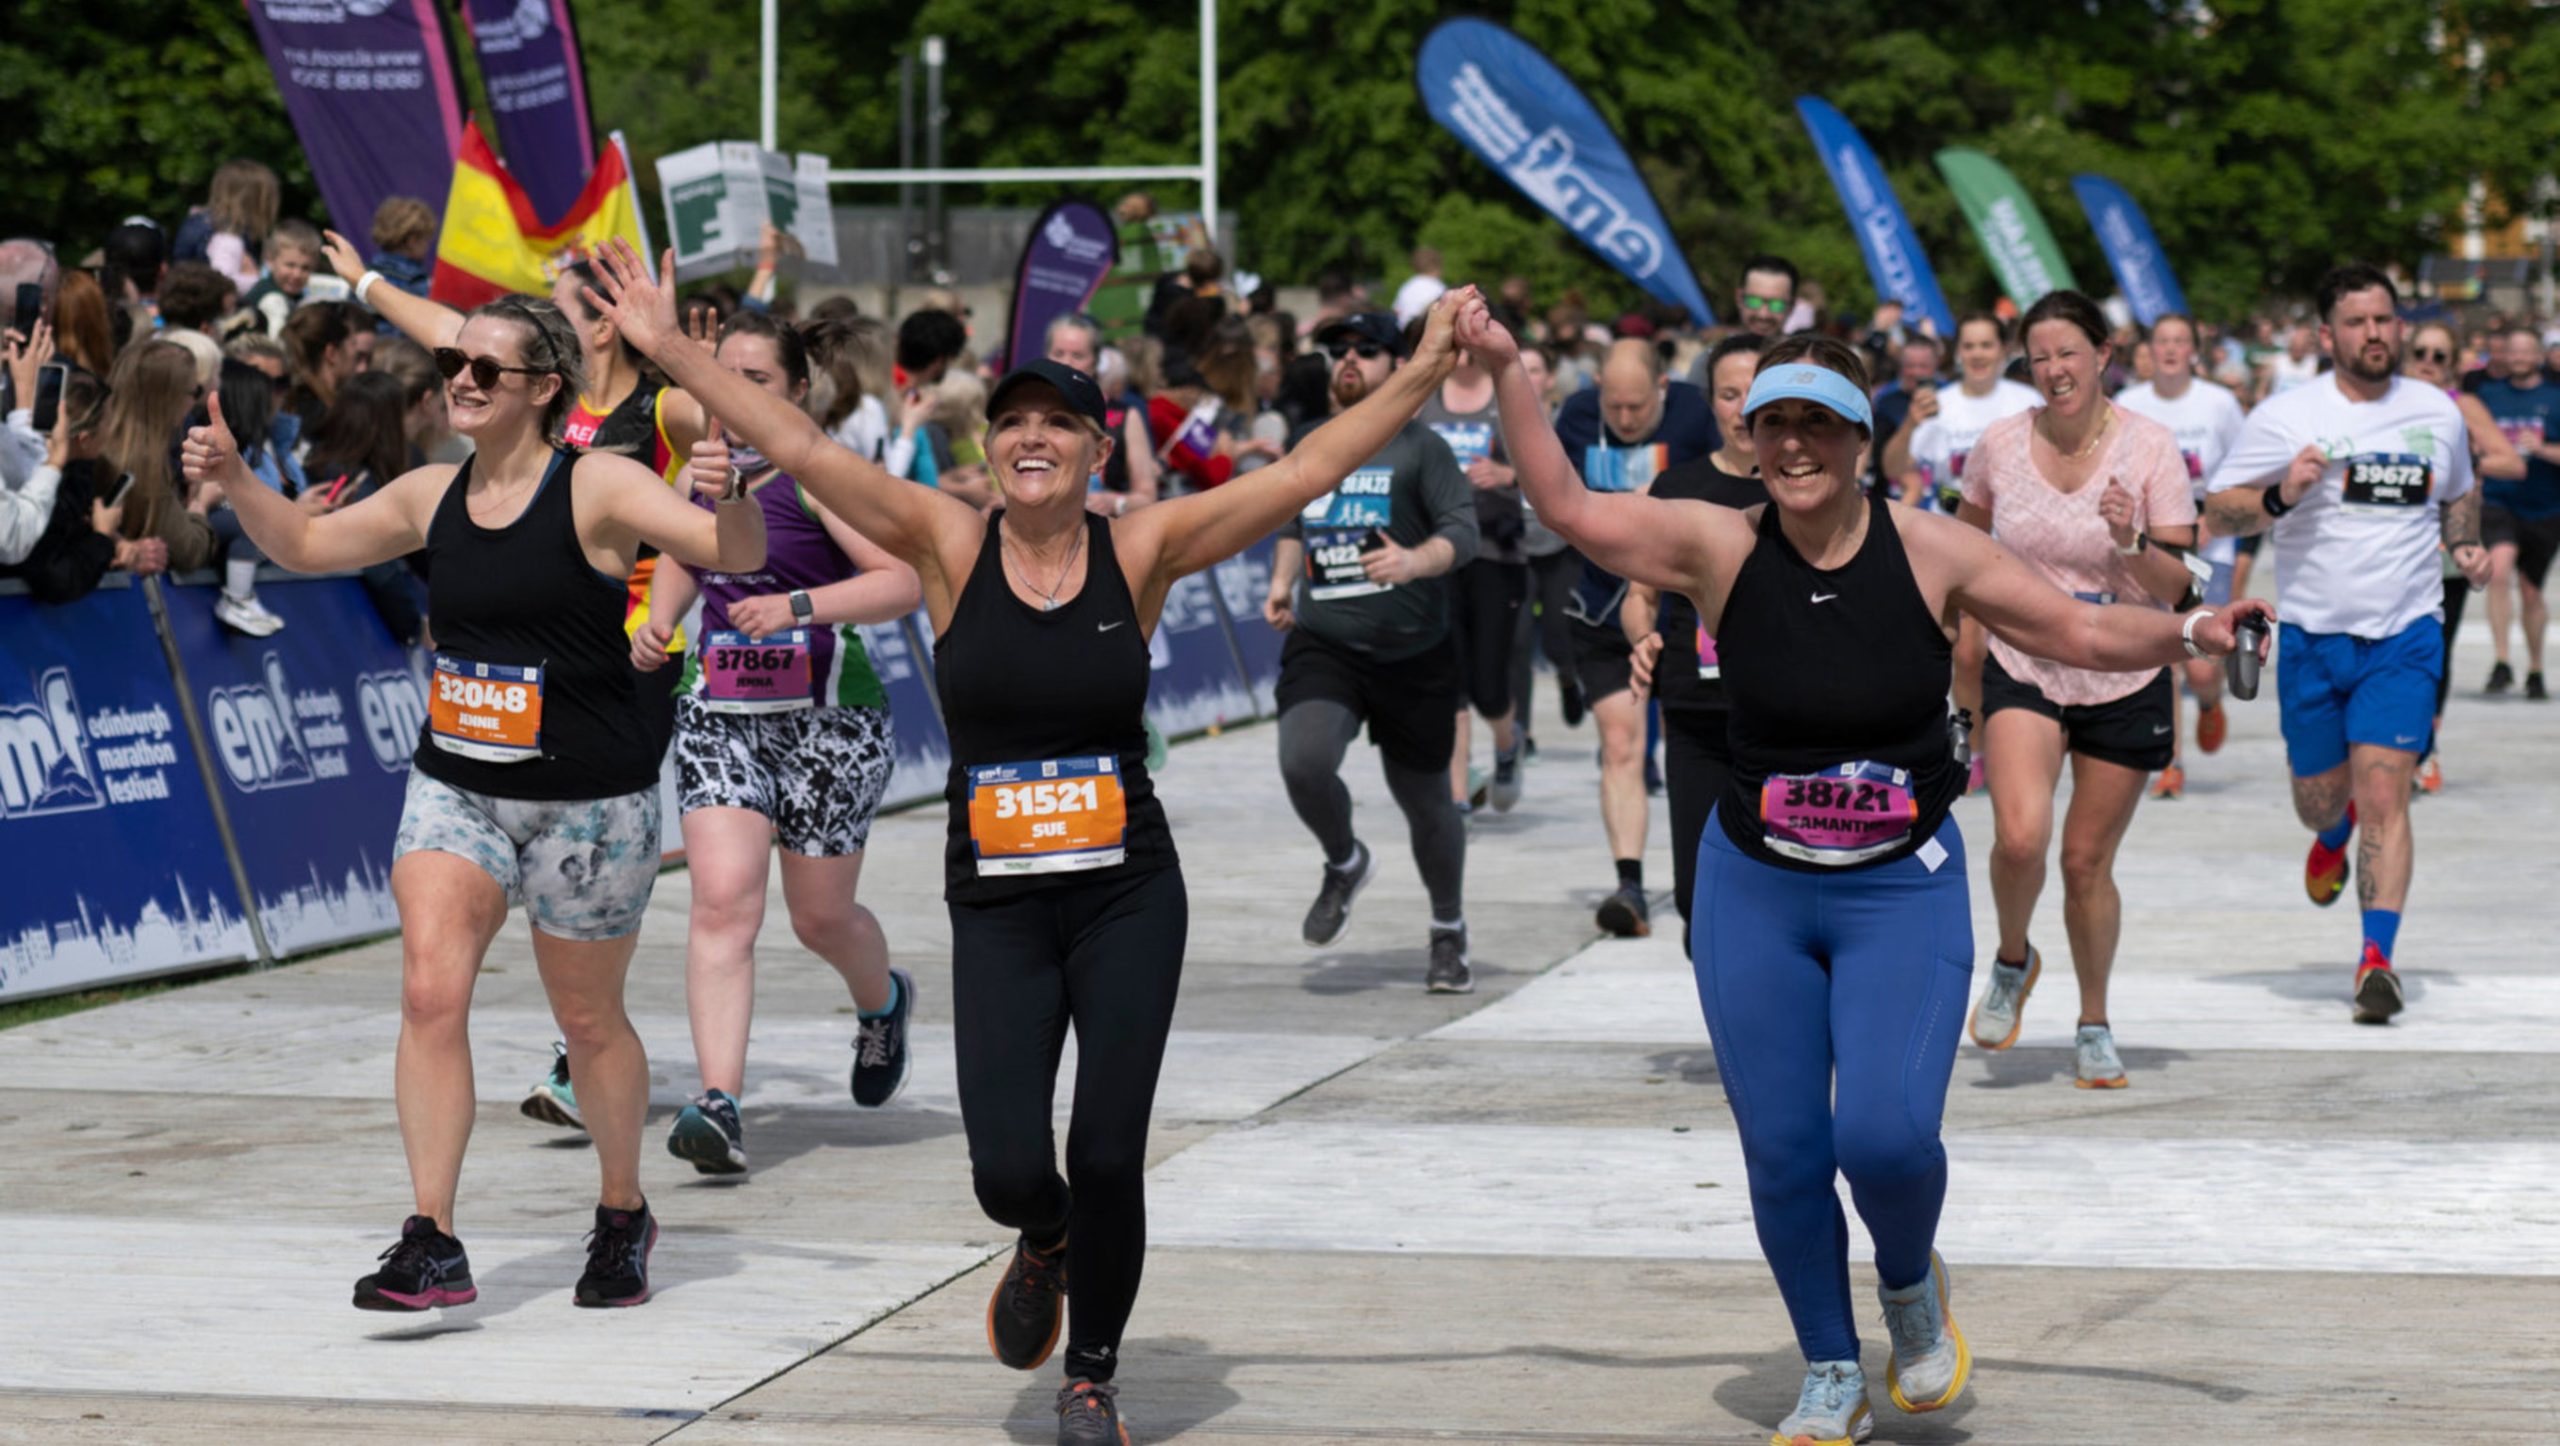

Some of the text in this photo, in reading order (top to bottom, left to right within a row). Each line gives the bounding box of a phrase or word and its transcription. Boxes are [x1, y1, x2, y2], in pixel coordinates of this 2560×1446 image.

[2353, 464, 2424, 486] 39672
[716, 648, 796, 672] 37867
[438, 674, 527, 713] 32048
[736, 676, 774, 688] JENNA
[87, 702, 172, 740] edinburgh
[209, 652, 312, 790] emf
[459, 712, 500, 730] JENNIE
[96, 737, 178, 771] marathon
[104, 768, 170, 804] festival
[995, 779, 1098, 819] 31521
[1784, 779, 1891, 812] 38721
[1032, 821, 1067, 838] SUE
